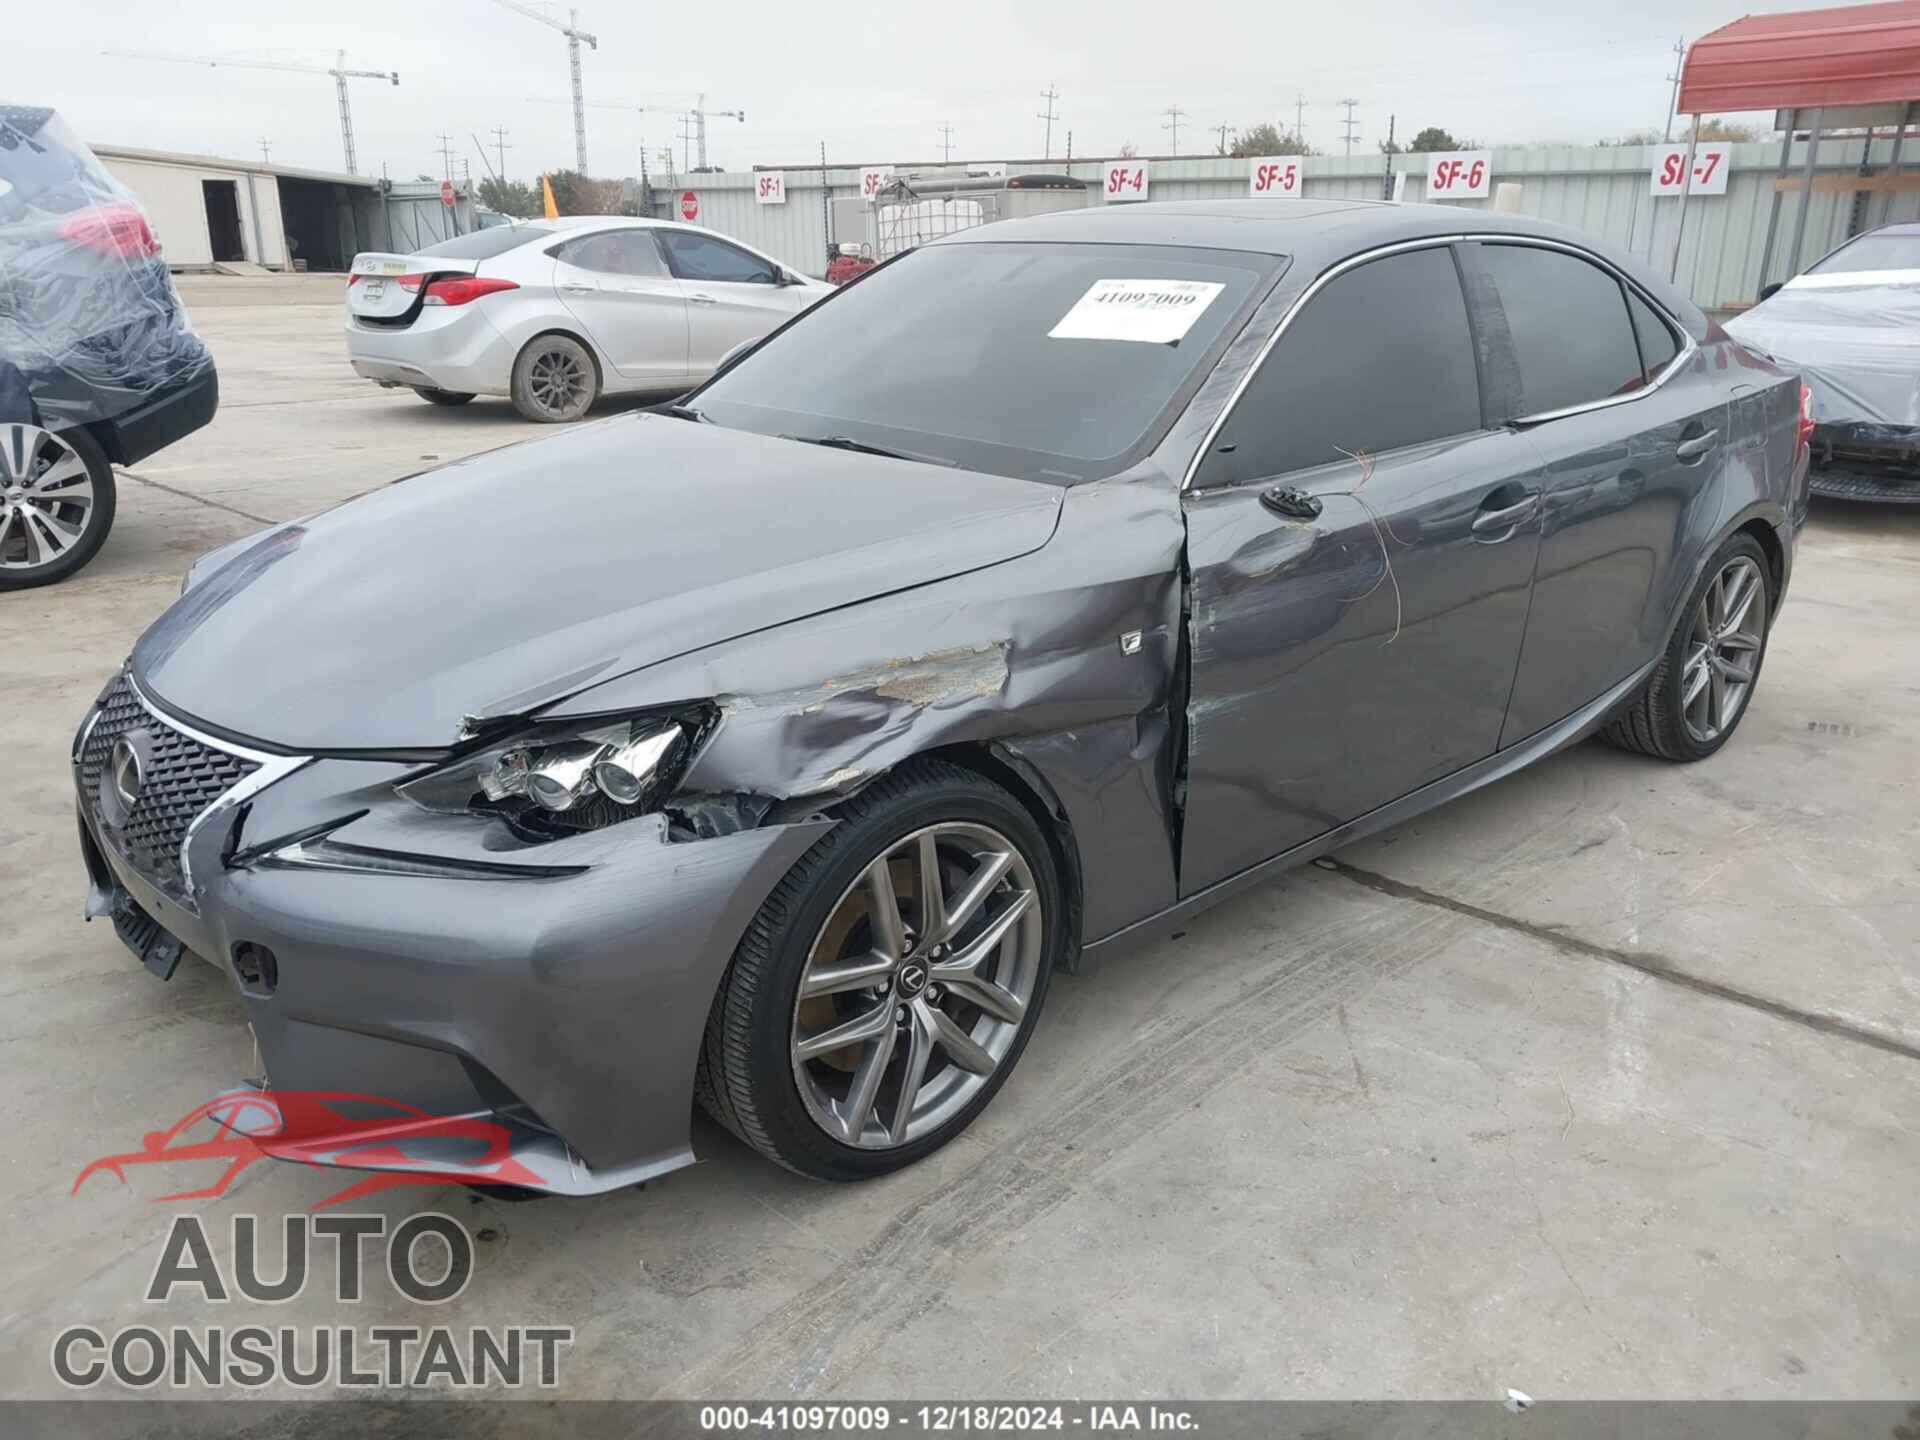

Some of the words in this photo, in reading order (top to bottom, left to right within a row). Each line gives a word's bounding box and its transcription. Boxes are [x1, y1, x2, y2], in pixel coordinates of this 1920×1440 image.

[760, 177, 780, 197] SF-1
[1108, 168, 1144, 193] SF-4
[1255, 164, 1297, 192] SF-5
[1433, 159, 1485, 190] SF-6
